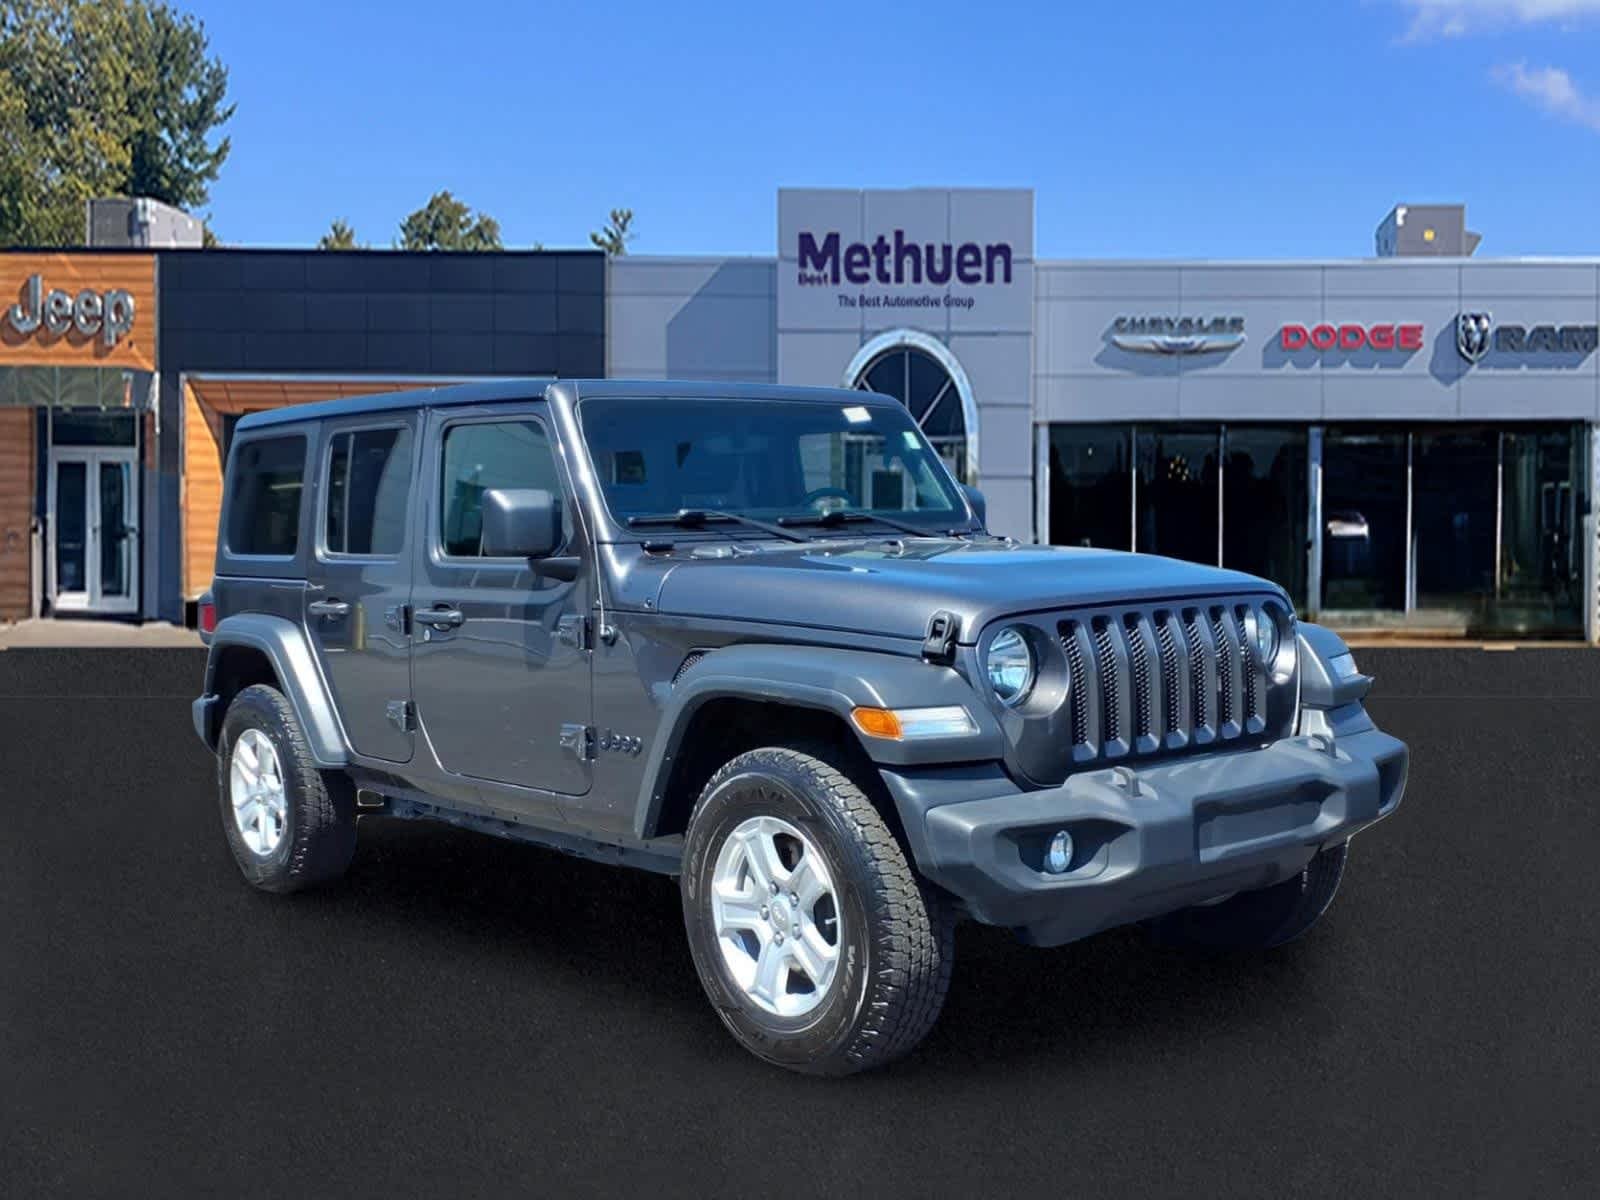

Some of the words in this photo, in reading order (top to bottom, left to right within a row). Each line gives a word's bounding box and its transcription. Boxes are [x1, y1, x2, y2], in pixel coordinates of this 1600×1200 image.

[798, 230, 1012, 285] Methuen
[9, 274, 135, 347] Jeep
[838, 295, 856, 307] The
[859, 294, 880, 307] Best
[883, 295, 940, 307] Automotive
[943, 294, 975, 311] Group
[1282, 324, 1424, 351] DODGE
[1495, 325, 1599, 352] RAM
